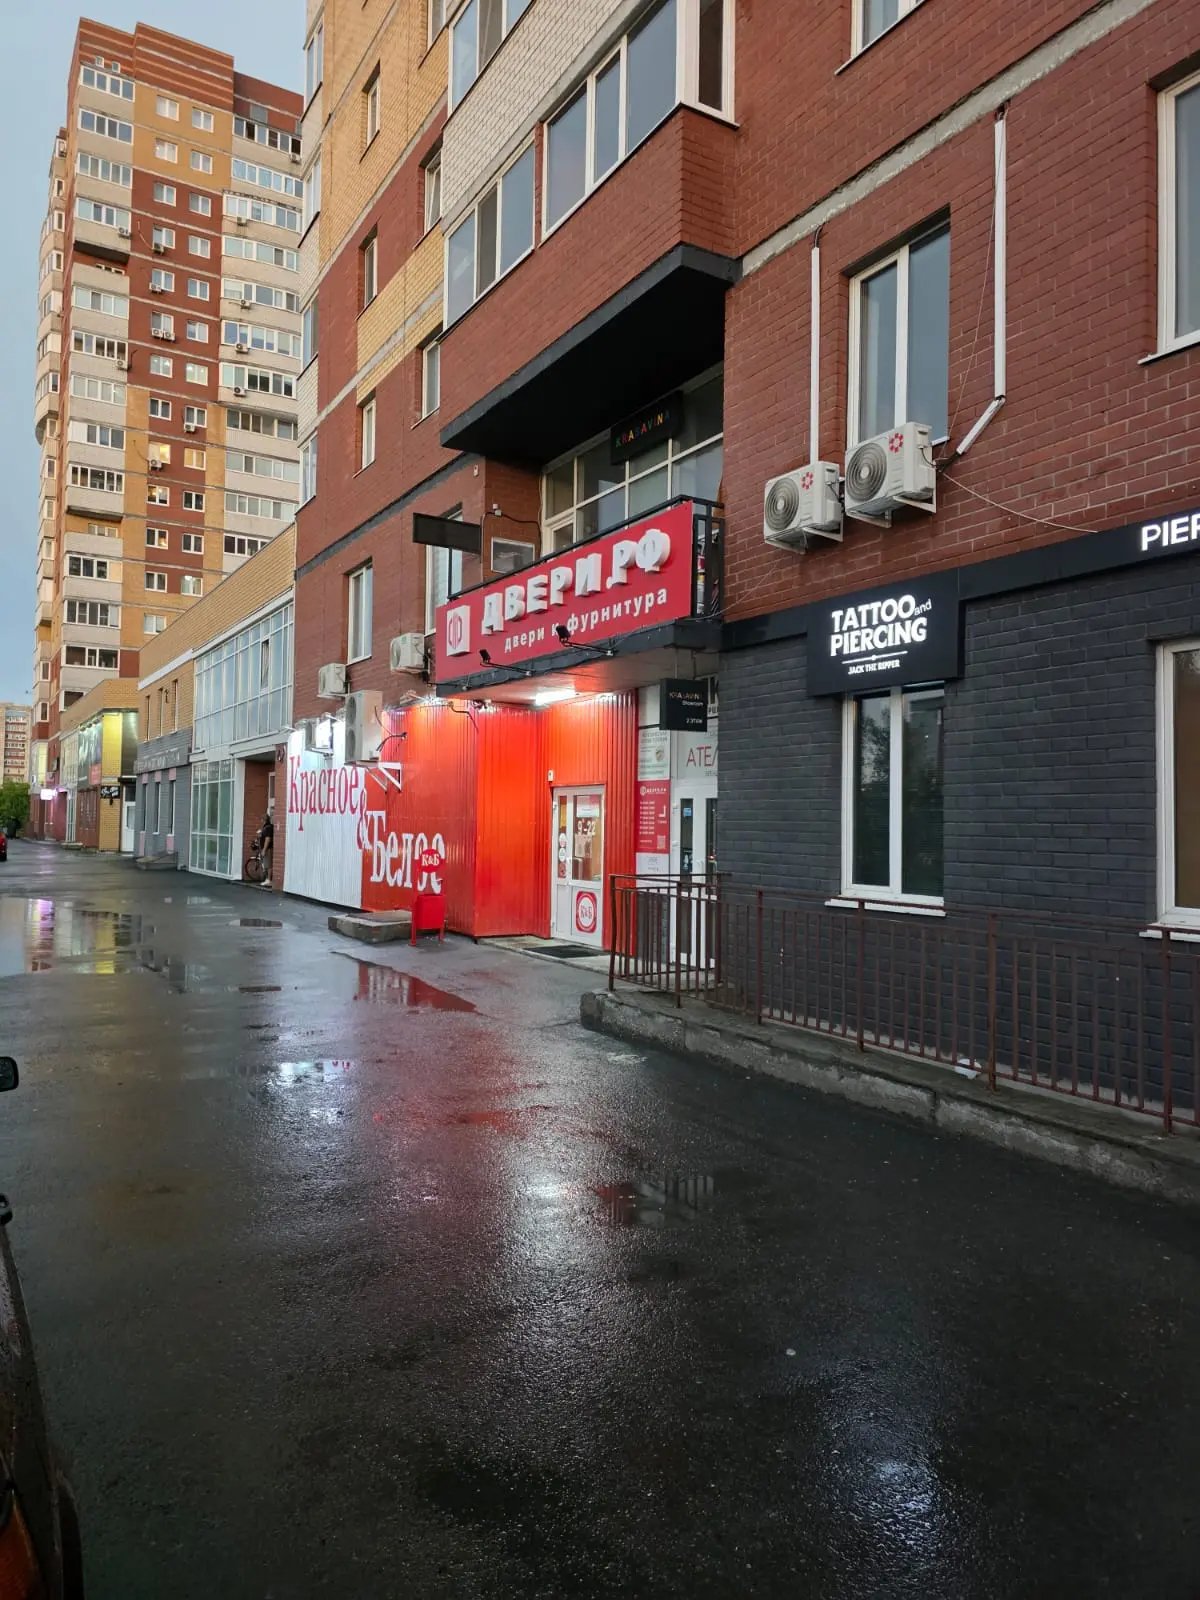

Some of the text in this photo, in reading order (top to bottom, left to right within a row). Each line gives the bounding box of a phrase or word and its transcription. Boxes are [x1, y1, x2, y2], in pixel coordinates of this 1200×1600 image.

[481, 528, 671, 636] ДВЕРИ.РФ
[504, 625, 546, 653] двери
[566, 588, 667, 635] фурнитура
[831, 594, 932, 632] TATTOO and
[830, 617, 928, 657] PIERCING
[848, 664, 864, 675] JACK
[865, 662, 877, 672] THE
[288, 755, 360, 831] Красное
[421, 853, 440, 867] К&Б
